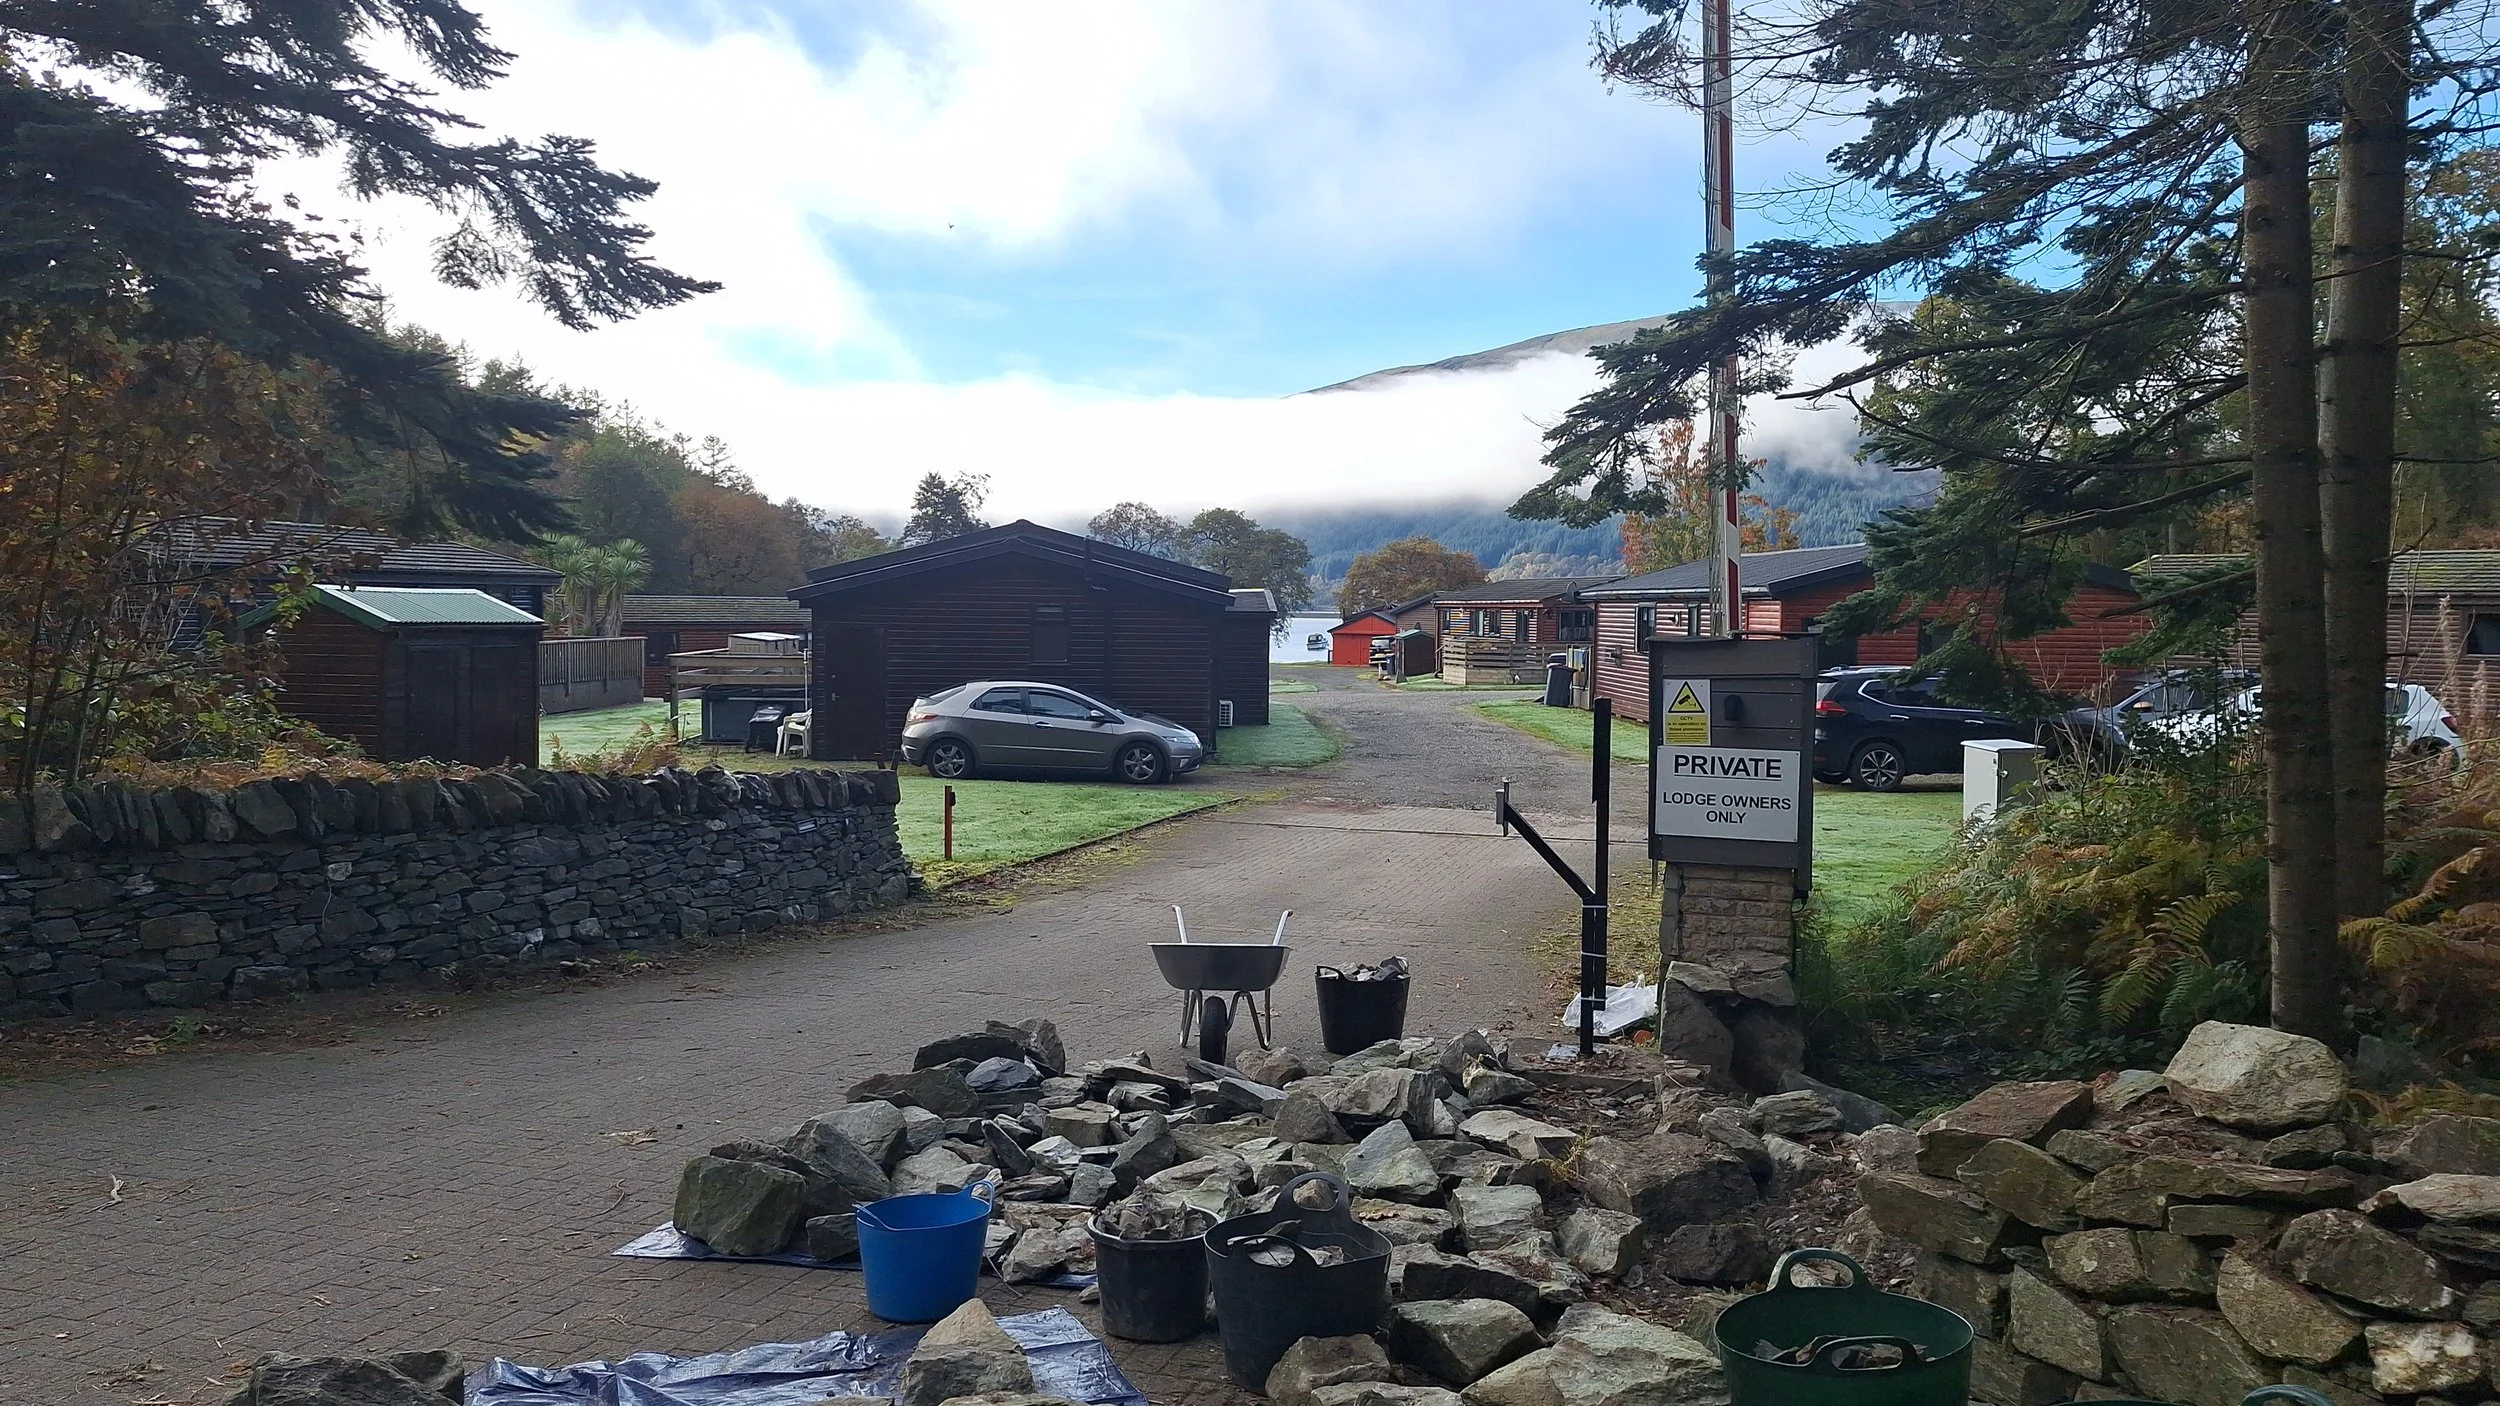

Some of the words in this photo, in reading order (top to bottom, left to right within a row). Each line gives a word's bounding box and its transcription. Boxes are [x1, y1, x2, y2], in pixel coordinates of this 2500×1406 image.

[1674, 754, 1782, 778] PRIVATE
[1663, 792, 1717, 806] LODGE
[1721, 794, 1792, 810] OWNERS
[1705, 810, 1747, 824] ONLY
